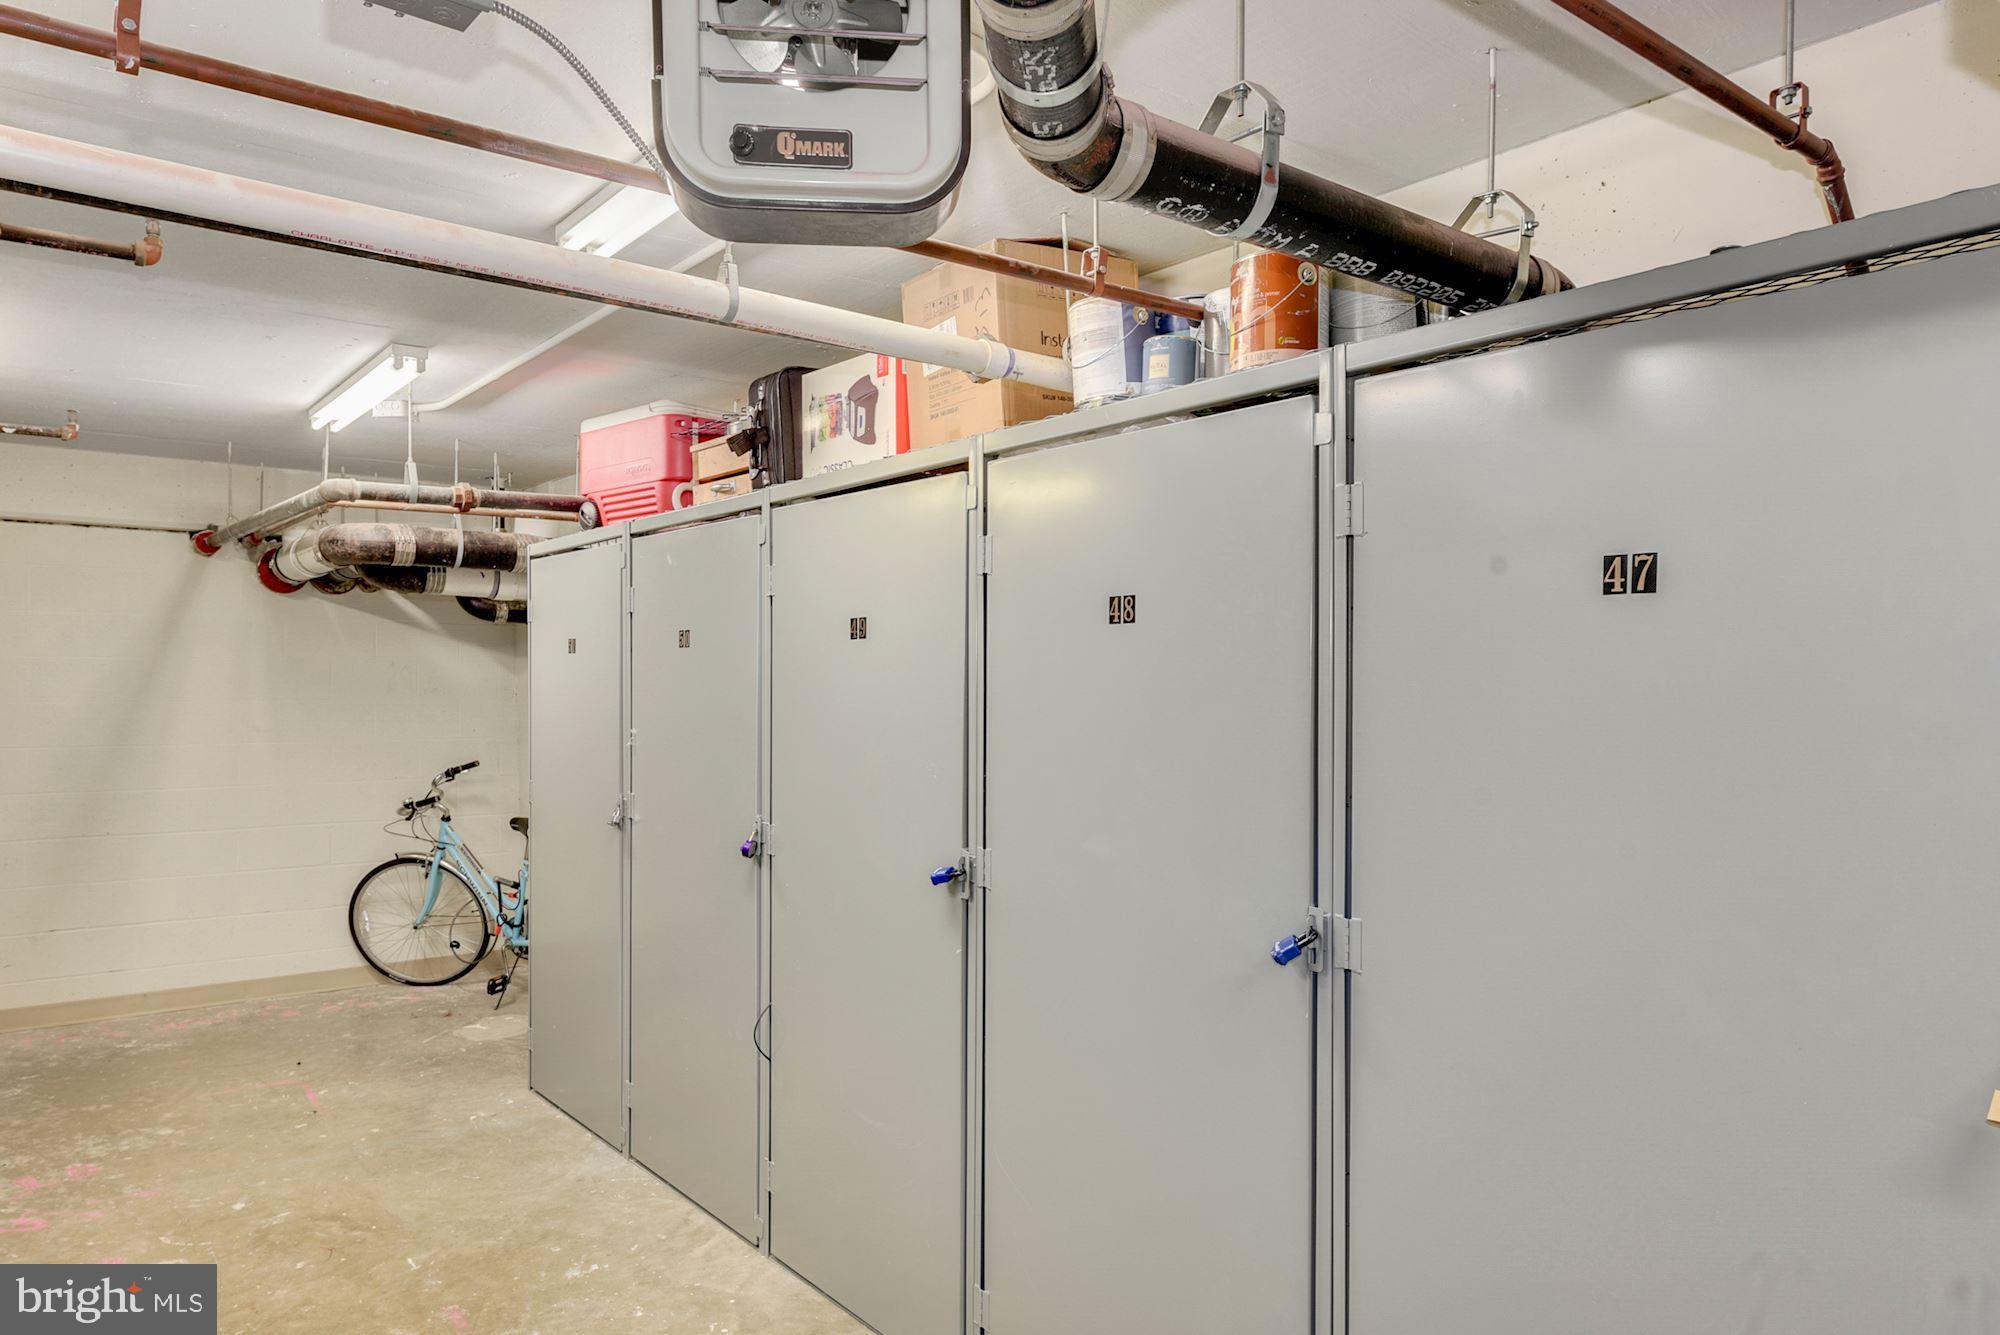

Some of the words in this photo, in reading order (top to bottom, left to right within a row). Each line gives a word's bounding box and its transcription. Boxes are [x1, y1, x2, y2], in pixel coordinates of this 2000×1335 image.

[776, 131, 845, 159] QMARK
[290, 229, 374, 251] CHARLOTTE
[1323, 252, 1378, 276] 888
[1380, 269, 1465, 304] 092205
[1603, 554, 1655, 593] 47
[1109, 596, 1135, 623] 48
[850, 618, 867, 640] 49
[456, 859, 490, 906] SCHWINN
